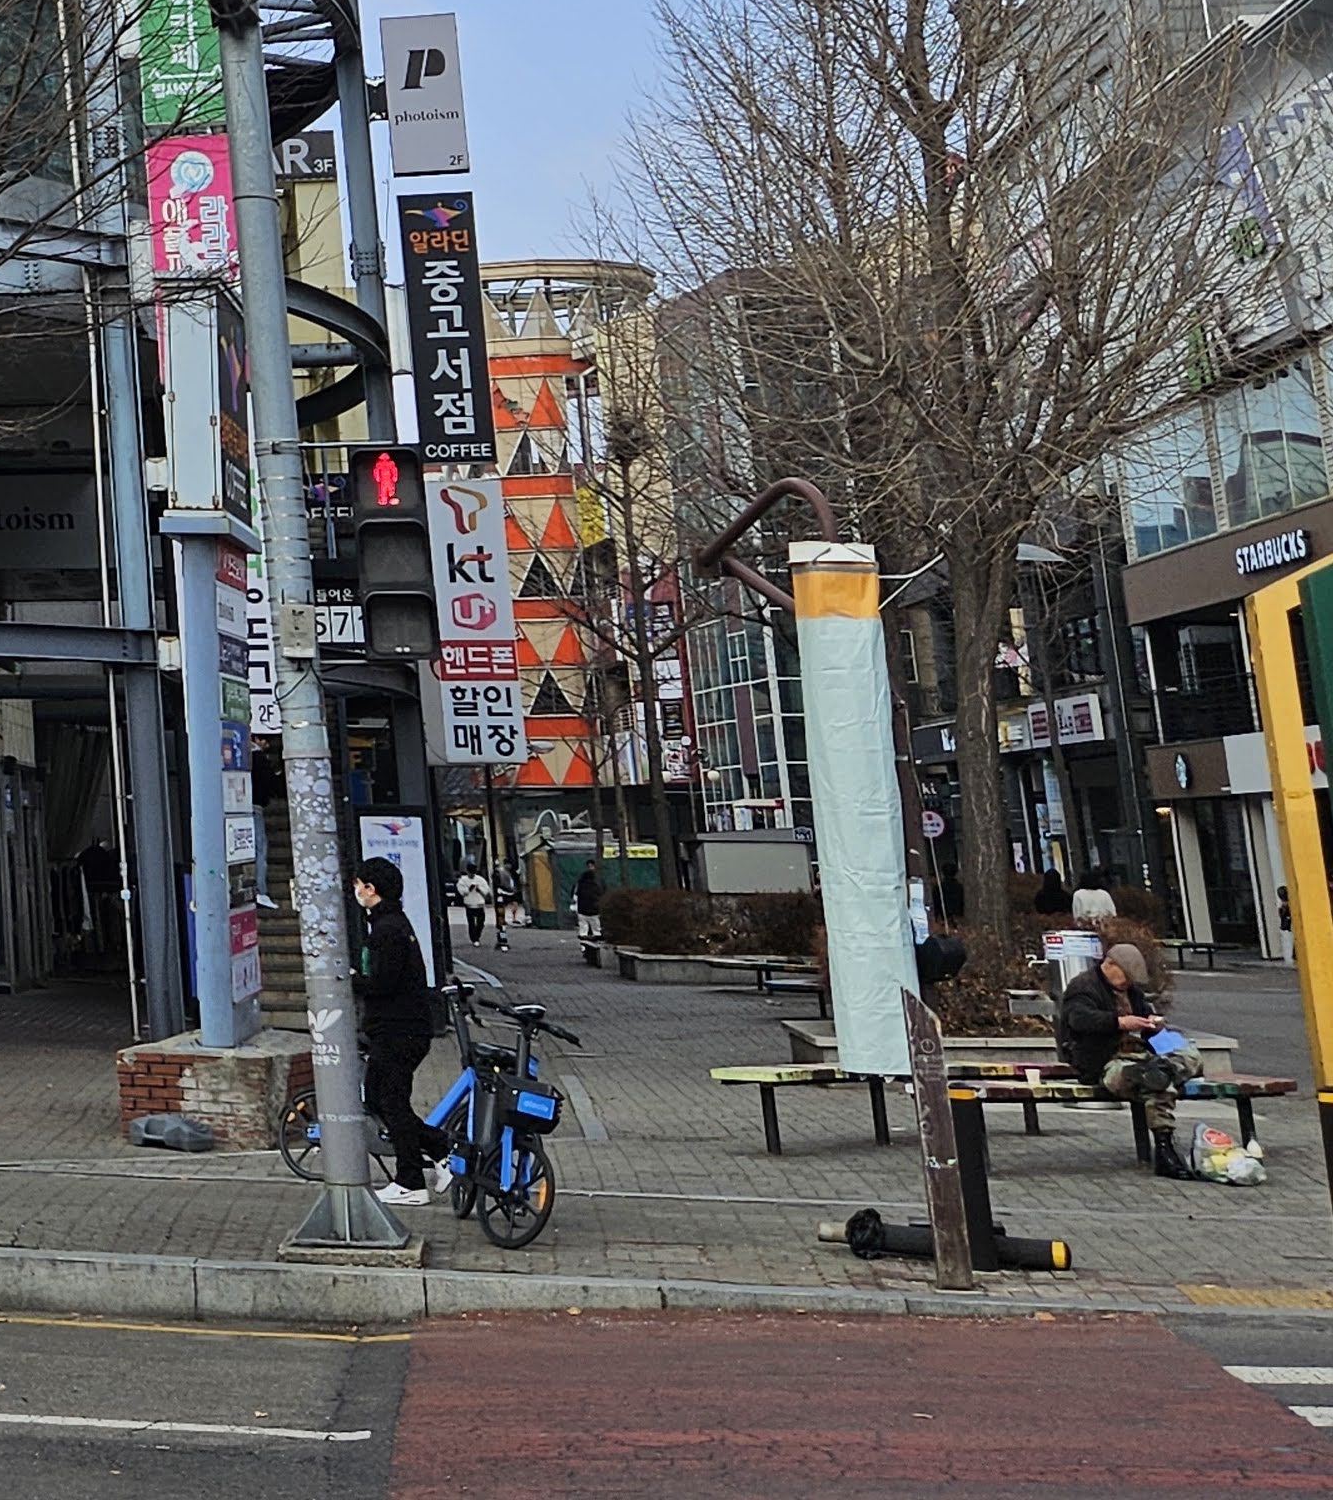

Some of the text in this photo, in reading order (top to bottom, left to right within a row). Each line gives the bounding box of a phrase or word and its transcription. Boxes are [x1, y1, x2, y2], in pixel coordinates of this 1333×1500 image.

[394, 107, 460, 126] photoism
[314, 159, 333, 173] 3F
[449, 155, 464, 167] 2F
[409, 230, 470, 254] 알라딘
[422, 260, 475, 435] 중고서점
[425, 443, 493, 458] COFFEE
[447, 543, 495, 583] kt
[1236, 529, 1306, 575] STARBUCKS
[441, 644, 515, 675] 핸드폰
[258, 705, 274, 722] 2F
[450, 686, 514, 717] 할인
[453, 723, 520, 757] 매장
